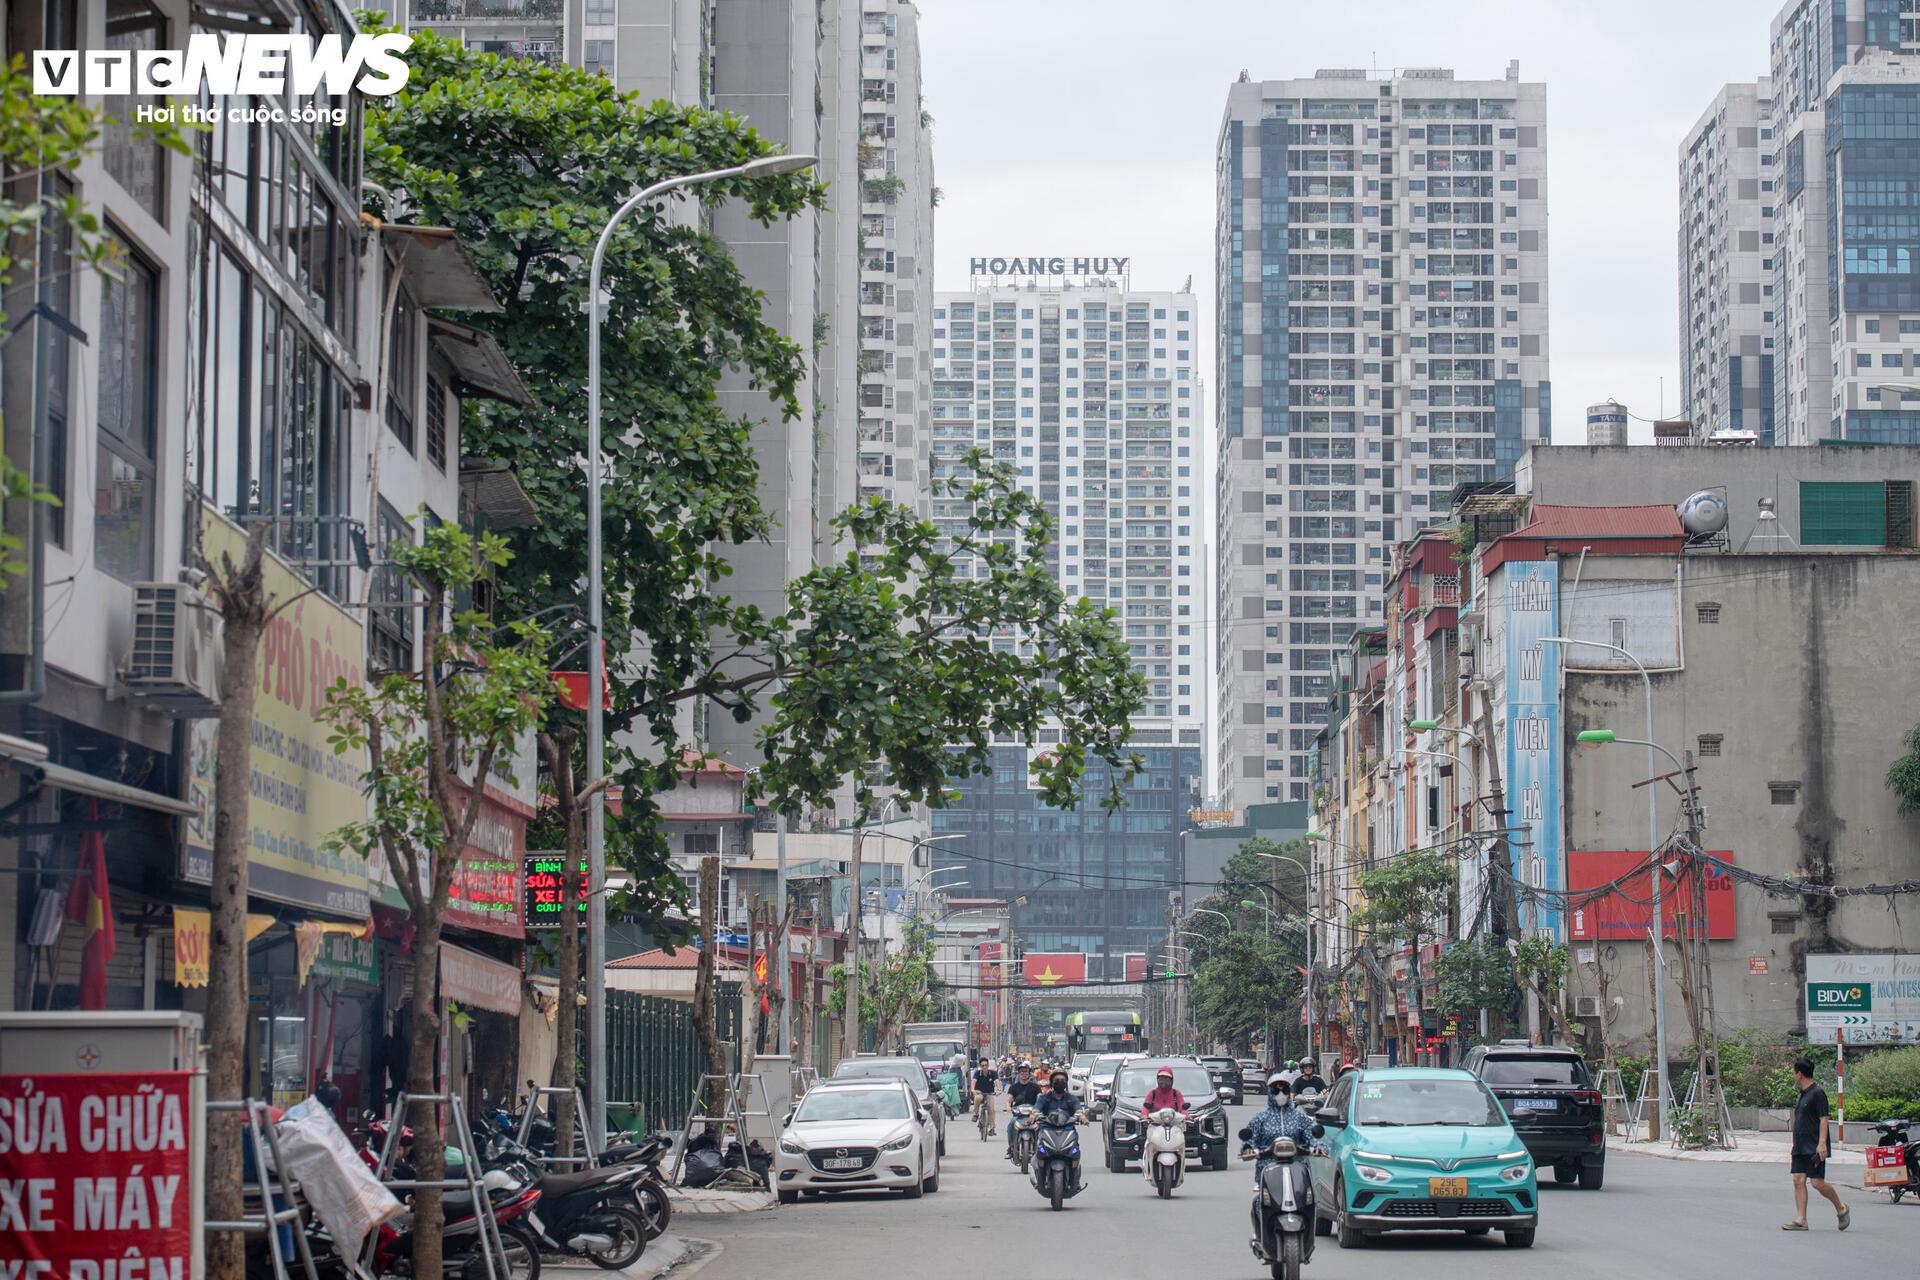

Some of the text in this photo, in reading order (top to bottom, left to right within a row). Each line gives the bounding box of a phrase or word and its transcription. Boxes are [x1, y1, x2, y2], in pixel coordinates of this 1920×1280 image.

[970, 257, 1129, 275] HOANG HUY
[1510, 568, 1551, 611] THẨM
[1520, 644, 1543, 681] MỸ
[1514, 712, 1549, 757] VIỆN
[1522, 782, 1543, 820] HÀ
[535, 861, 561, 873] BÌNH
[535, 890, 554, 902] XE
[1817, 990, 1849, 1002] BIDV
[79, 1083, 186, 1153] CHỮA
[73, 1164, 181, 1231] MÁY
